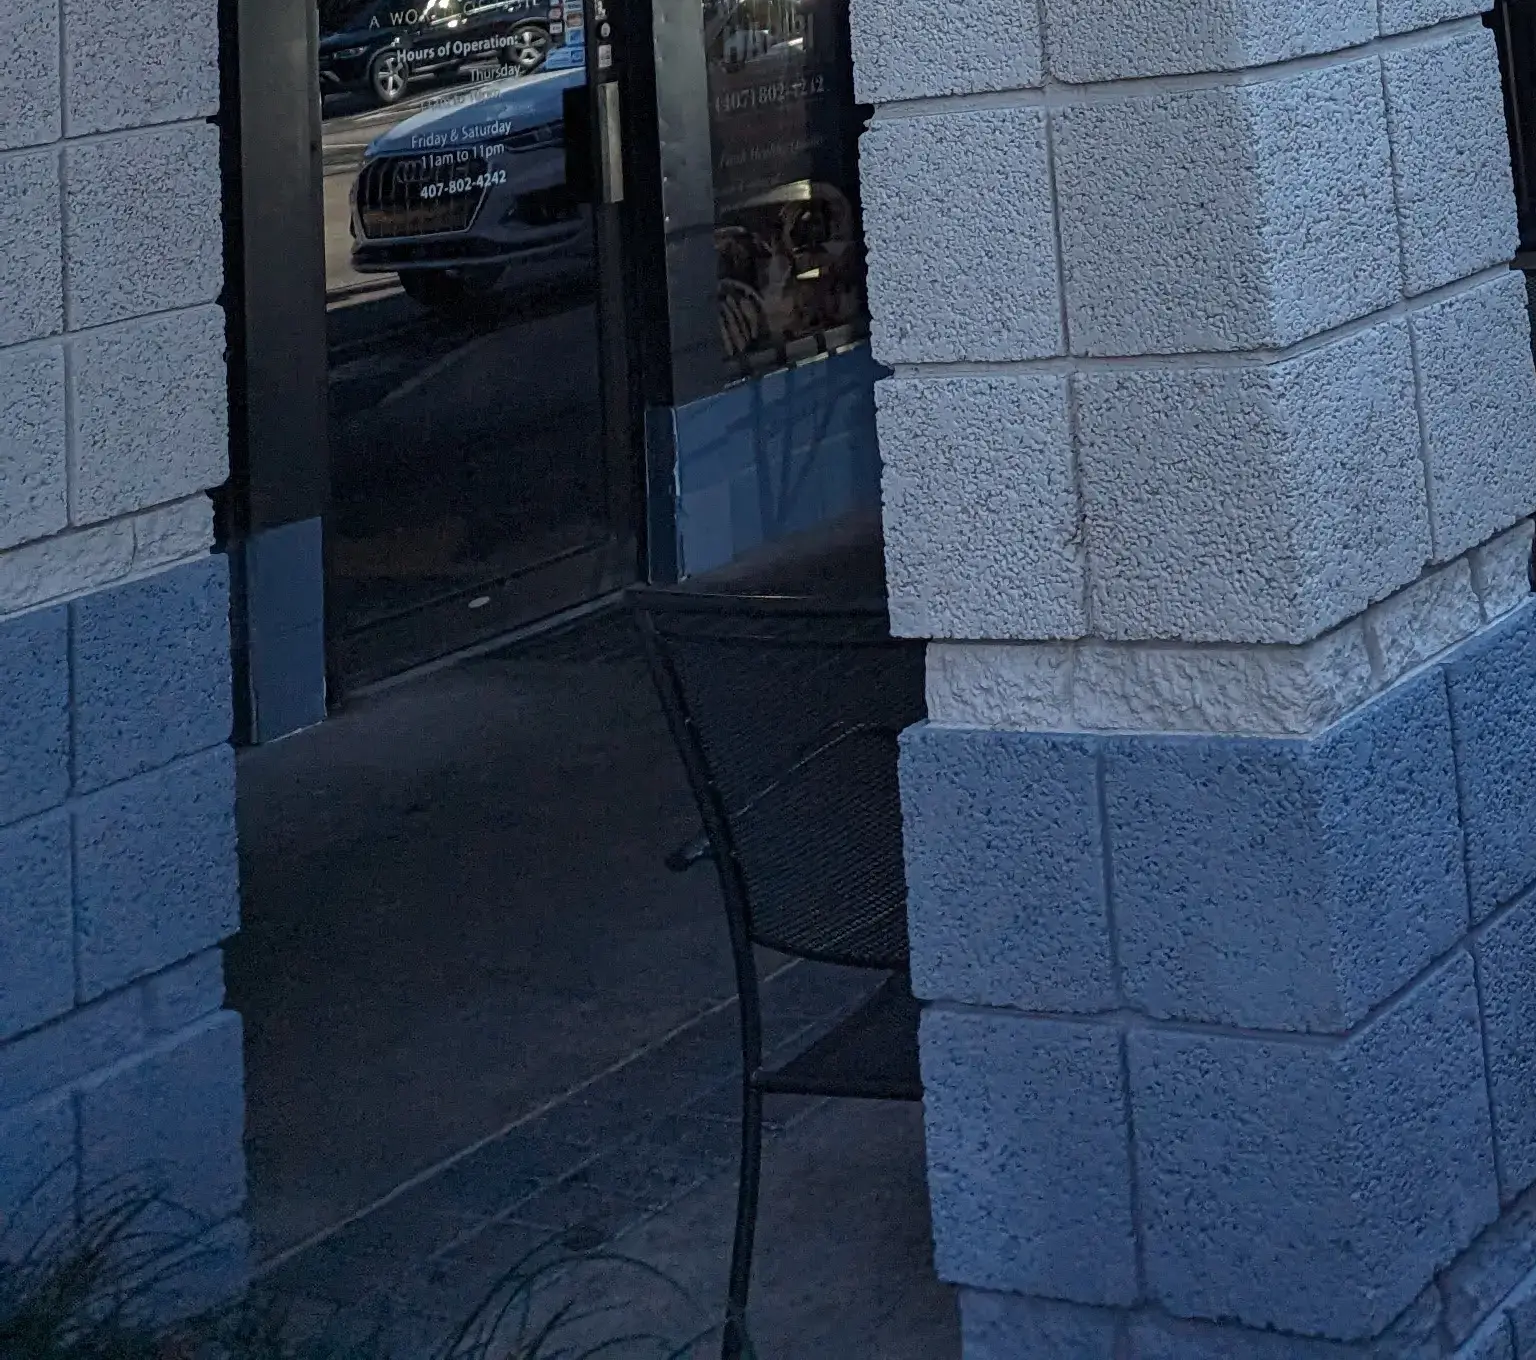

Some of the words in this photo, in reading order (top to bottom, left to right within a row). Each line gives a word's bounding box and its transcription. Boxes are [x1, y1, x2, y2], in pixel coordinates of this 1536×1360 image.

[396, 49, 435, 64] Hours
[437, 41, 451, 56] of
[453, 34, 519, 58] Operation:
[470, 63, 522, 82] Thursday
[411, 133, 447, 150] Friday
[450, 127, 459, 143] &
[461, 119, 513, 142] Saturday
[421, 151, 455, 170] 11am
[456, 149, 469, 163] to
[472, 142, 505, 165] 11pm
[420, 169, 508, 199] 407-802-4242
